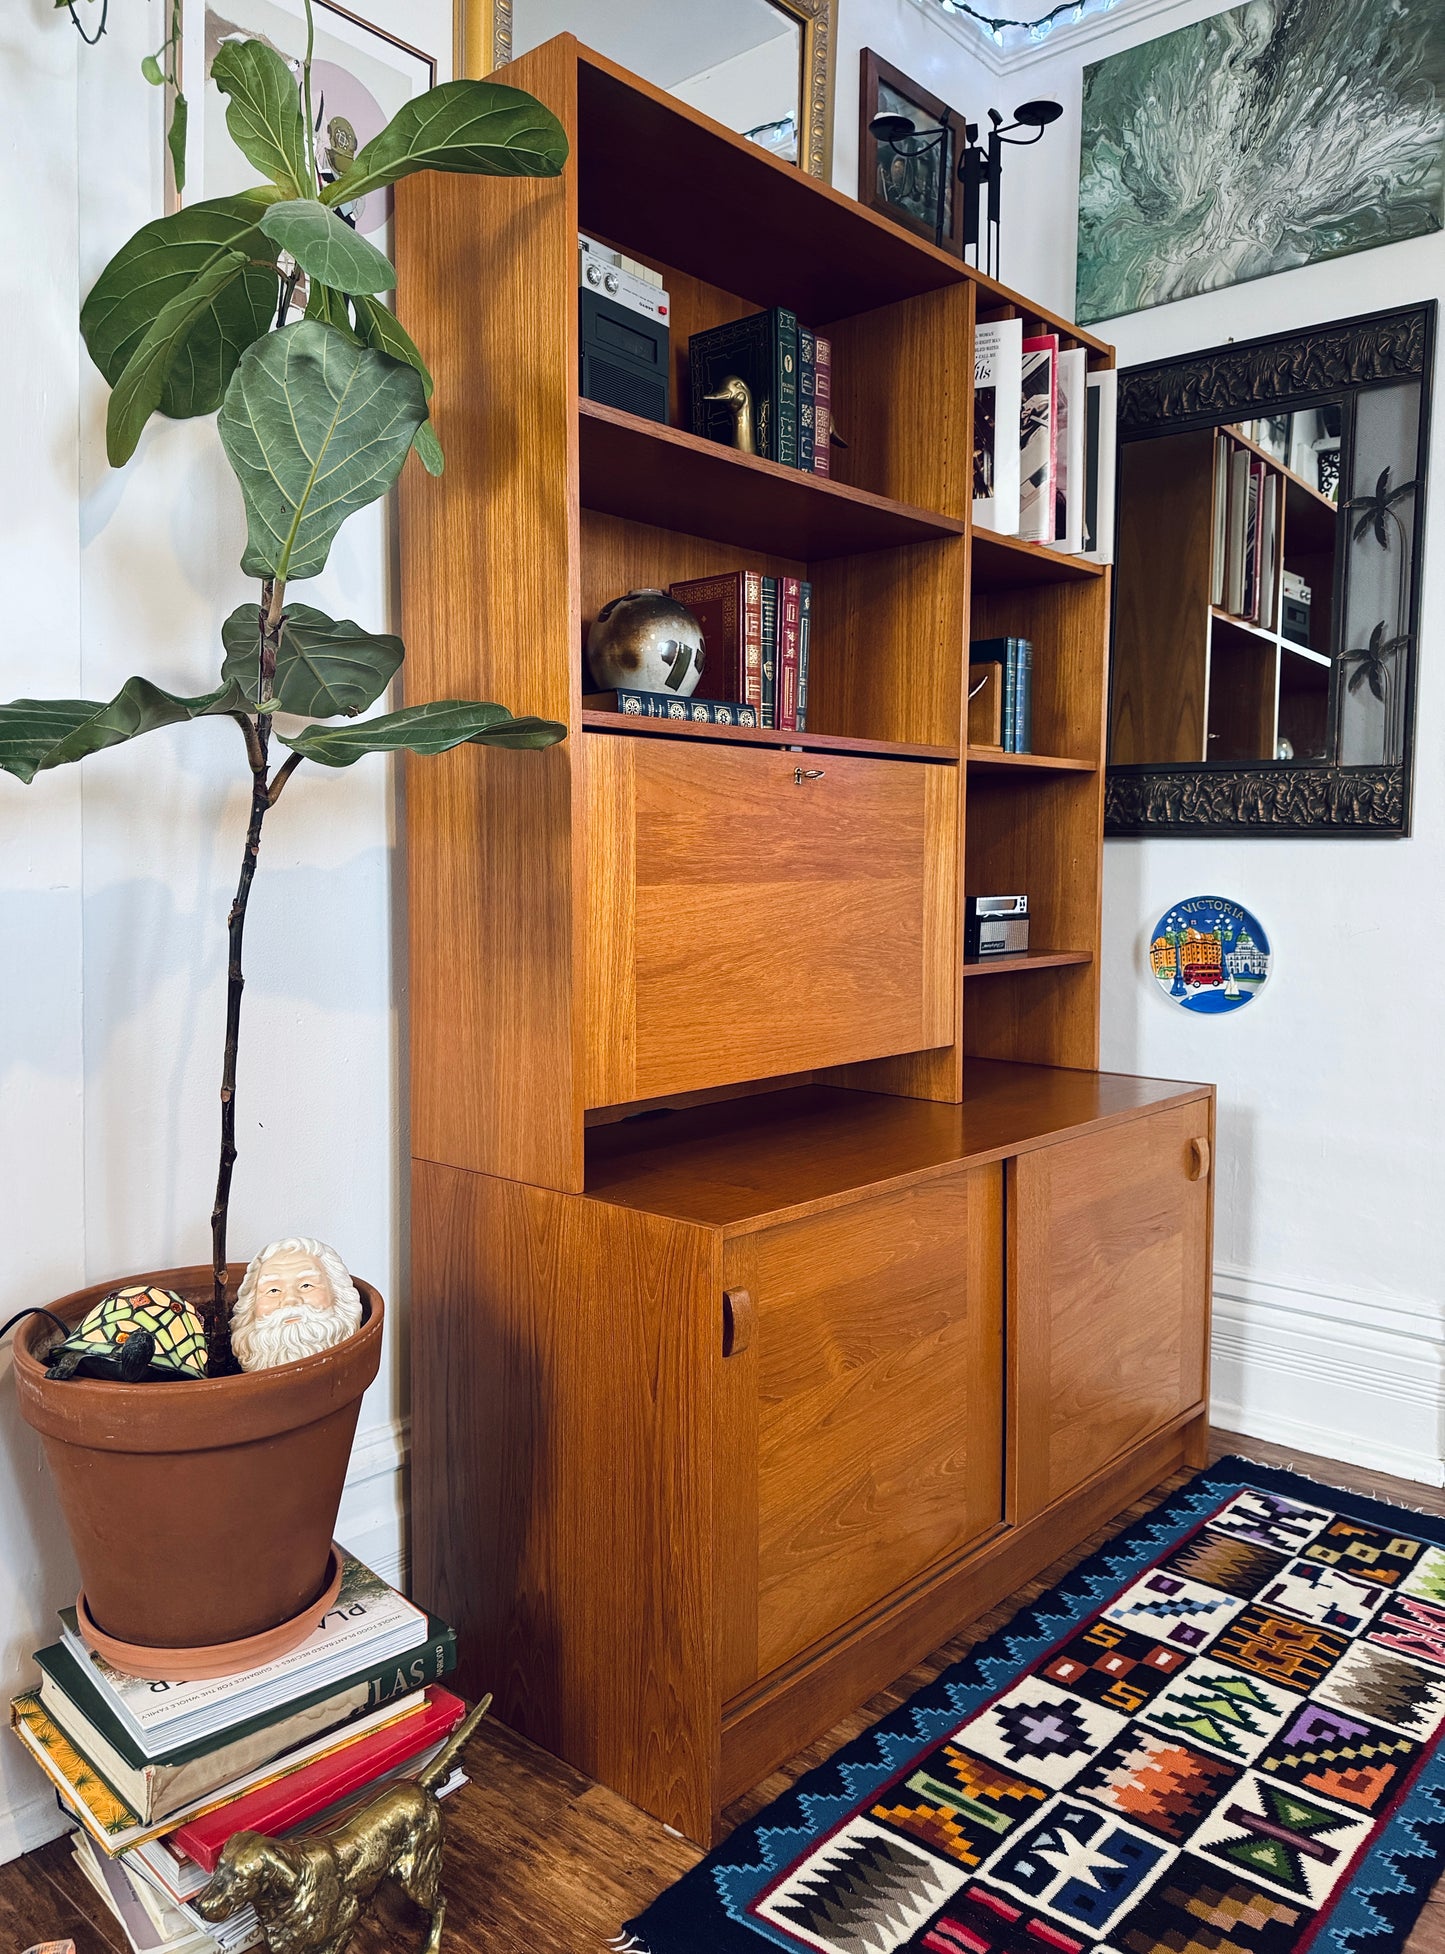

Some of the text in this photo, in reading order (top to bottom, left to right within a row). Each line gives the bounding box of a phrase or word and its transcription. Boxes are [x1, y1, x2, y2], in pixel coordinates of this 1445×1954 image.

[1181, 899, 1244, 921] VICTORIA
[356, 1624, 377, 1636] FOOD
[233, 1666, 273, 1685] GUIDANCE
[199, 1688, 217, 1698] THE
[217, 1682, 233, 1692] FOR
[172, 1694, 200, 1709] WHOLE
[141, 1704, 170, 1721] FAMILY
